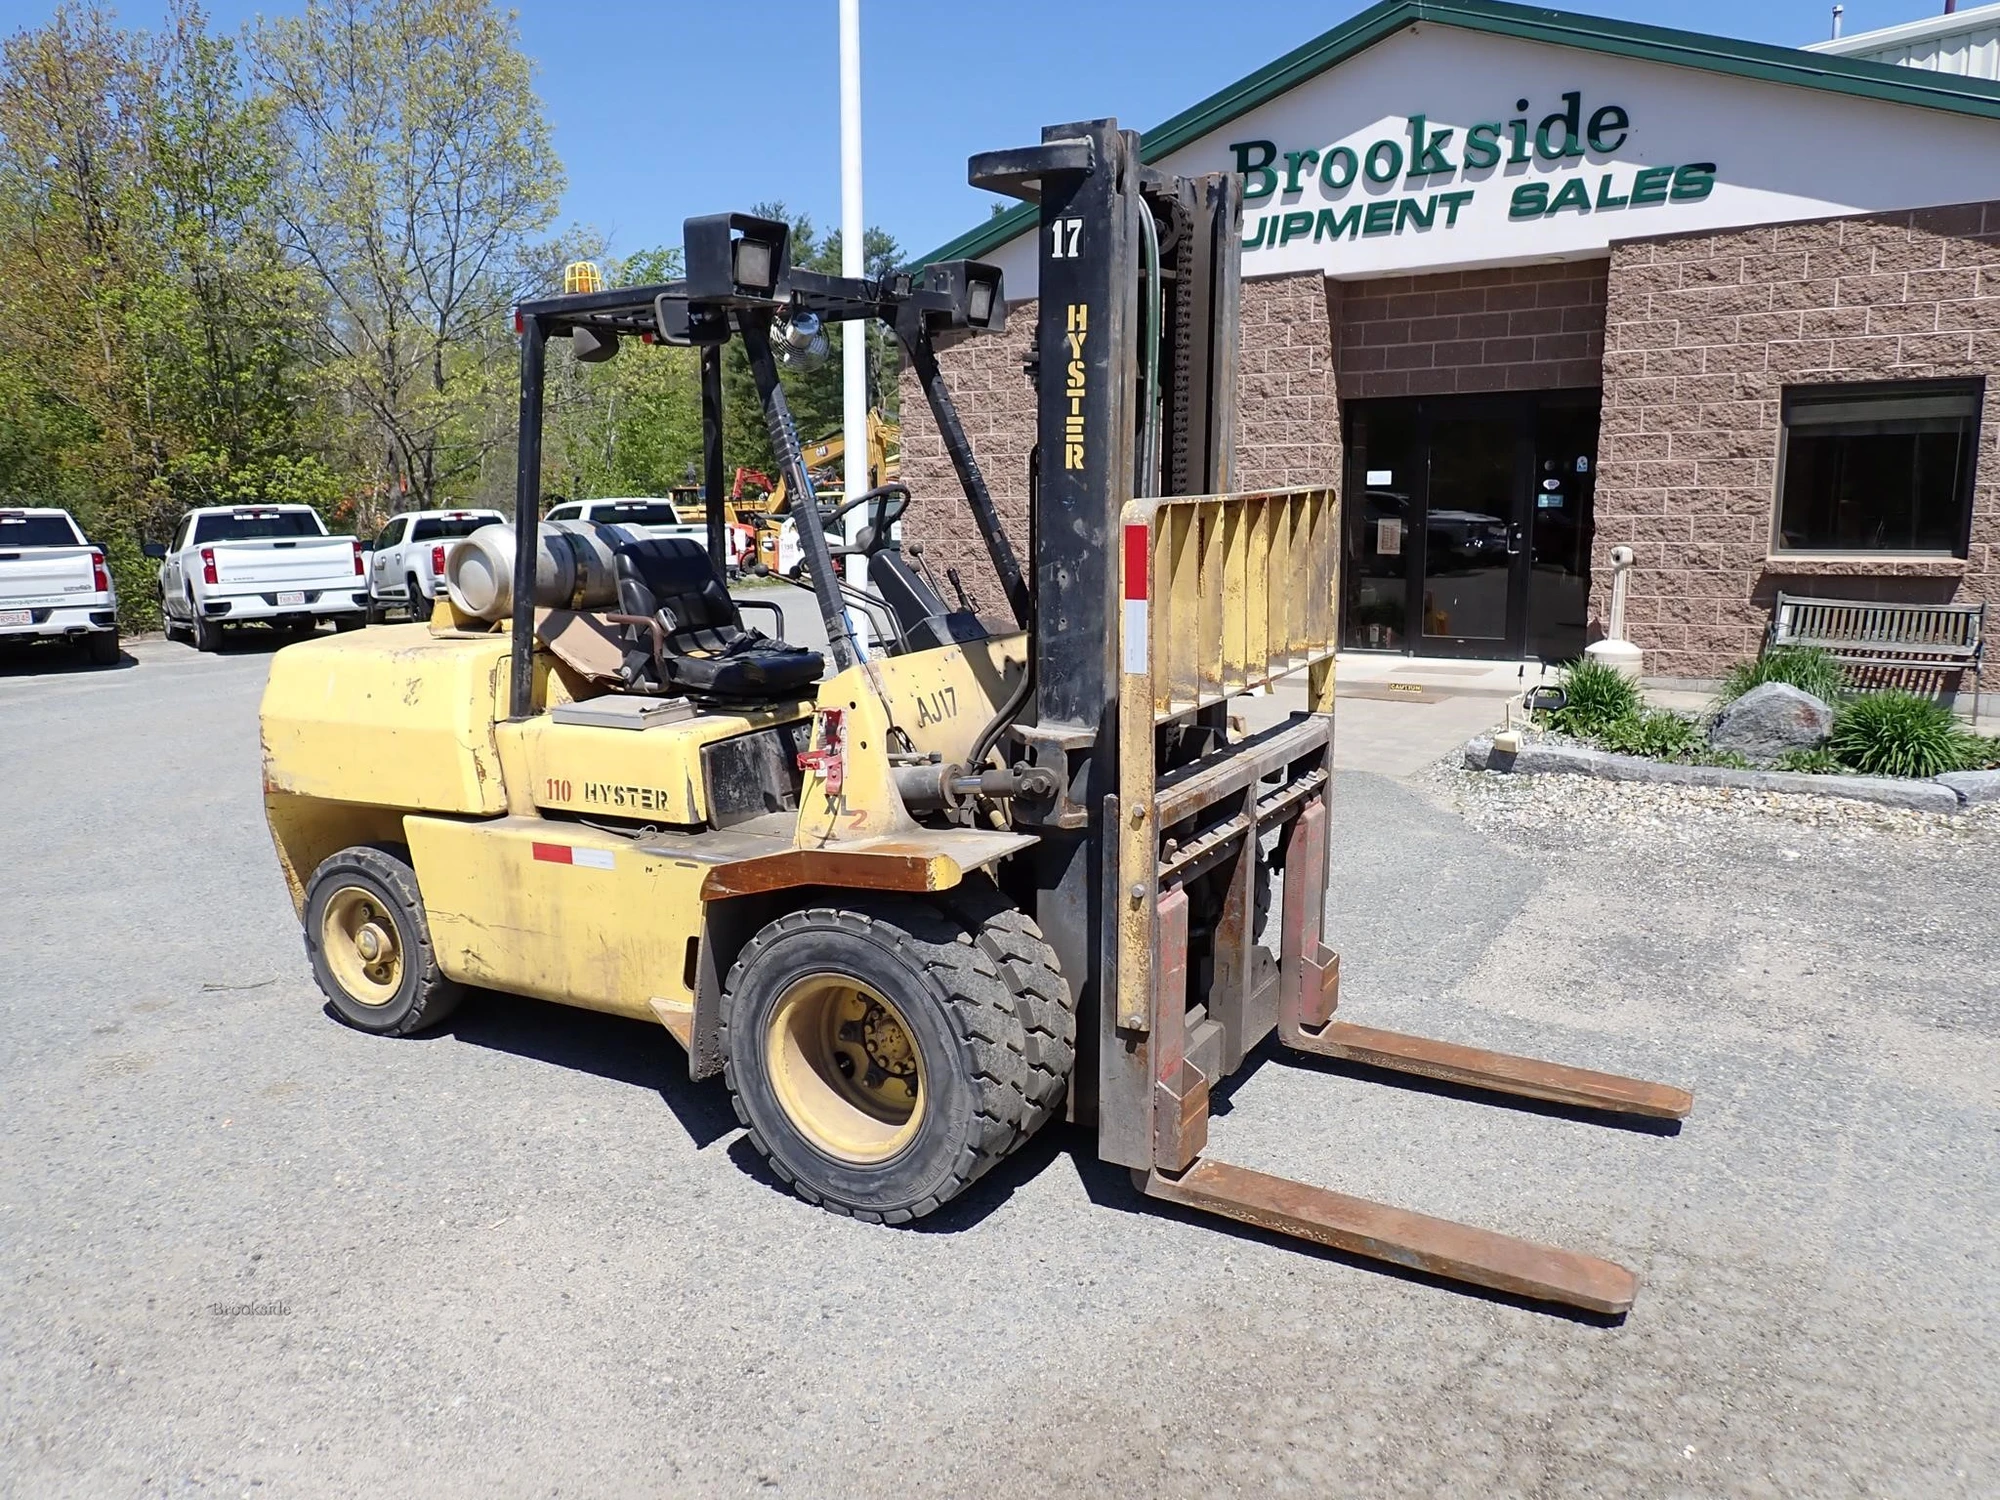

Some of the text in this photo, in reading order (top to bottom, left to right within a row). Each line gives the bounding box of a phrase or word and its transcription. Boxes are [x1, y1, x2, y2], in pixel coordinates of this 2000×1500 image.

[1230, 91, 1629, 199] Brookside
[1508, 163, 1717, 218] SALES
[1051, 219, 1083, 259] 17
[1065, 304, 1088, 470] HYSTER
[917, 687, 957, 729] AJ17
[546, 778, 669, 812] 110 HYSTER
[824, 795, 868, 831] XL 2
